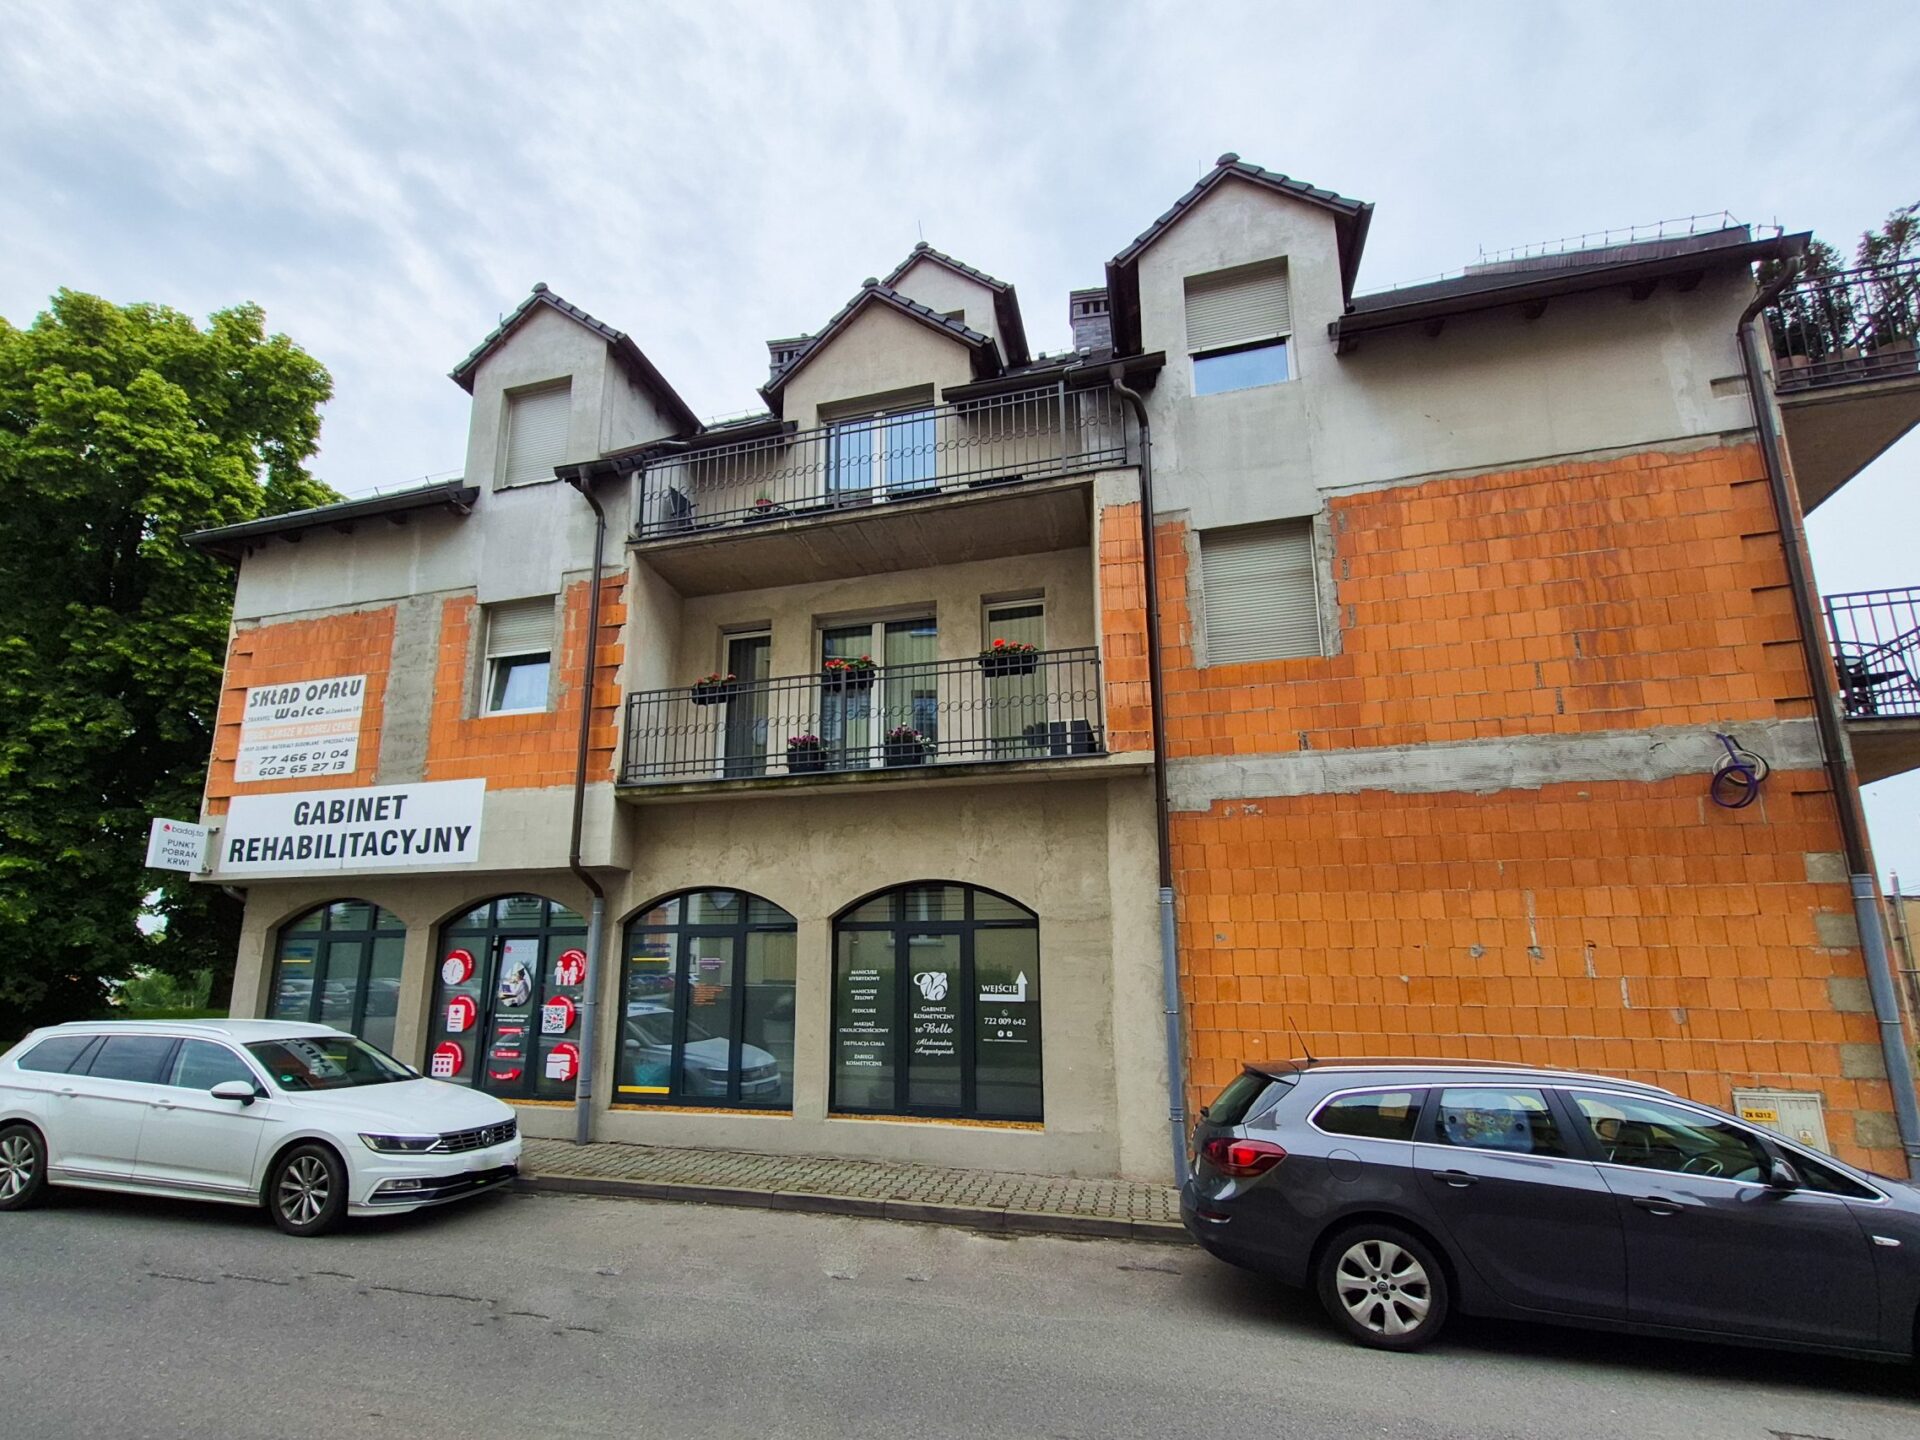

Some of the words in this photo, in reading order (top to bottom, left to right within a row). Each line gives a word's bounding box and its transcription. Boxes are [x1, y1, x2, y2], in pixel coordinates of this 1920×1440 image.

[250, 687, 300, 707] SKŁAD
[306, 679, 362, 701] OPAŁU
[275, 706, 325, 719] Walce
[260, 756, 277, 764] 77
[280, 753, 308, 763] 466
[312, 752, 325, 760] 01
[330, 749, 349, 758] 04
[258, 766, 285, 776] 602
[290, 764, 307, 773] 65
[311, 762, 329, 771] 27
[332, 761, 346, 770] 13
[294, 794, 408, 826] GABINET
[168, 839, 195, 849] PUNKT
[228, 826, 472, 862] REHABILITACYJNY
[167, 858, 190, 866] KRWI
[981, 984, 1018, 993] WEJŚCIE
